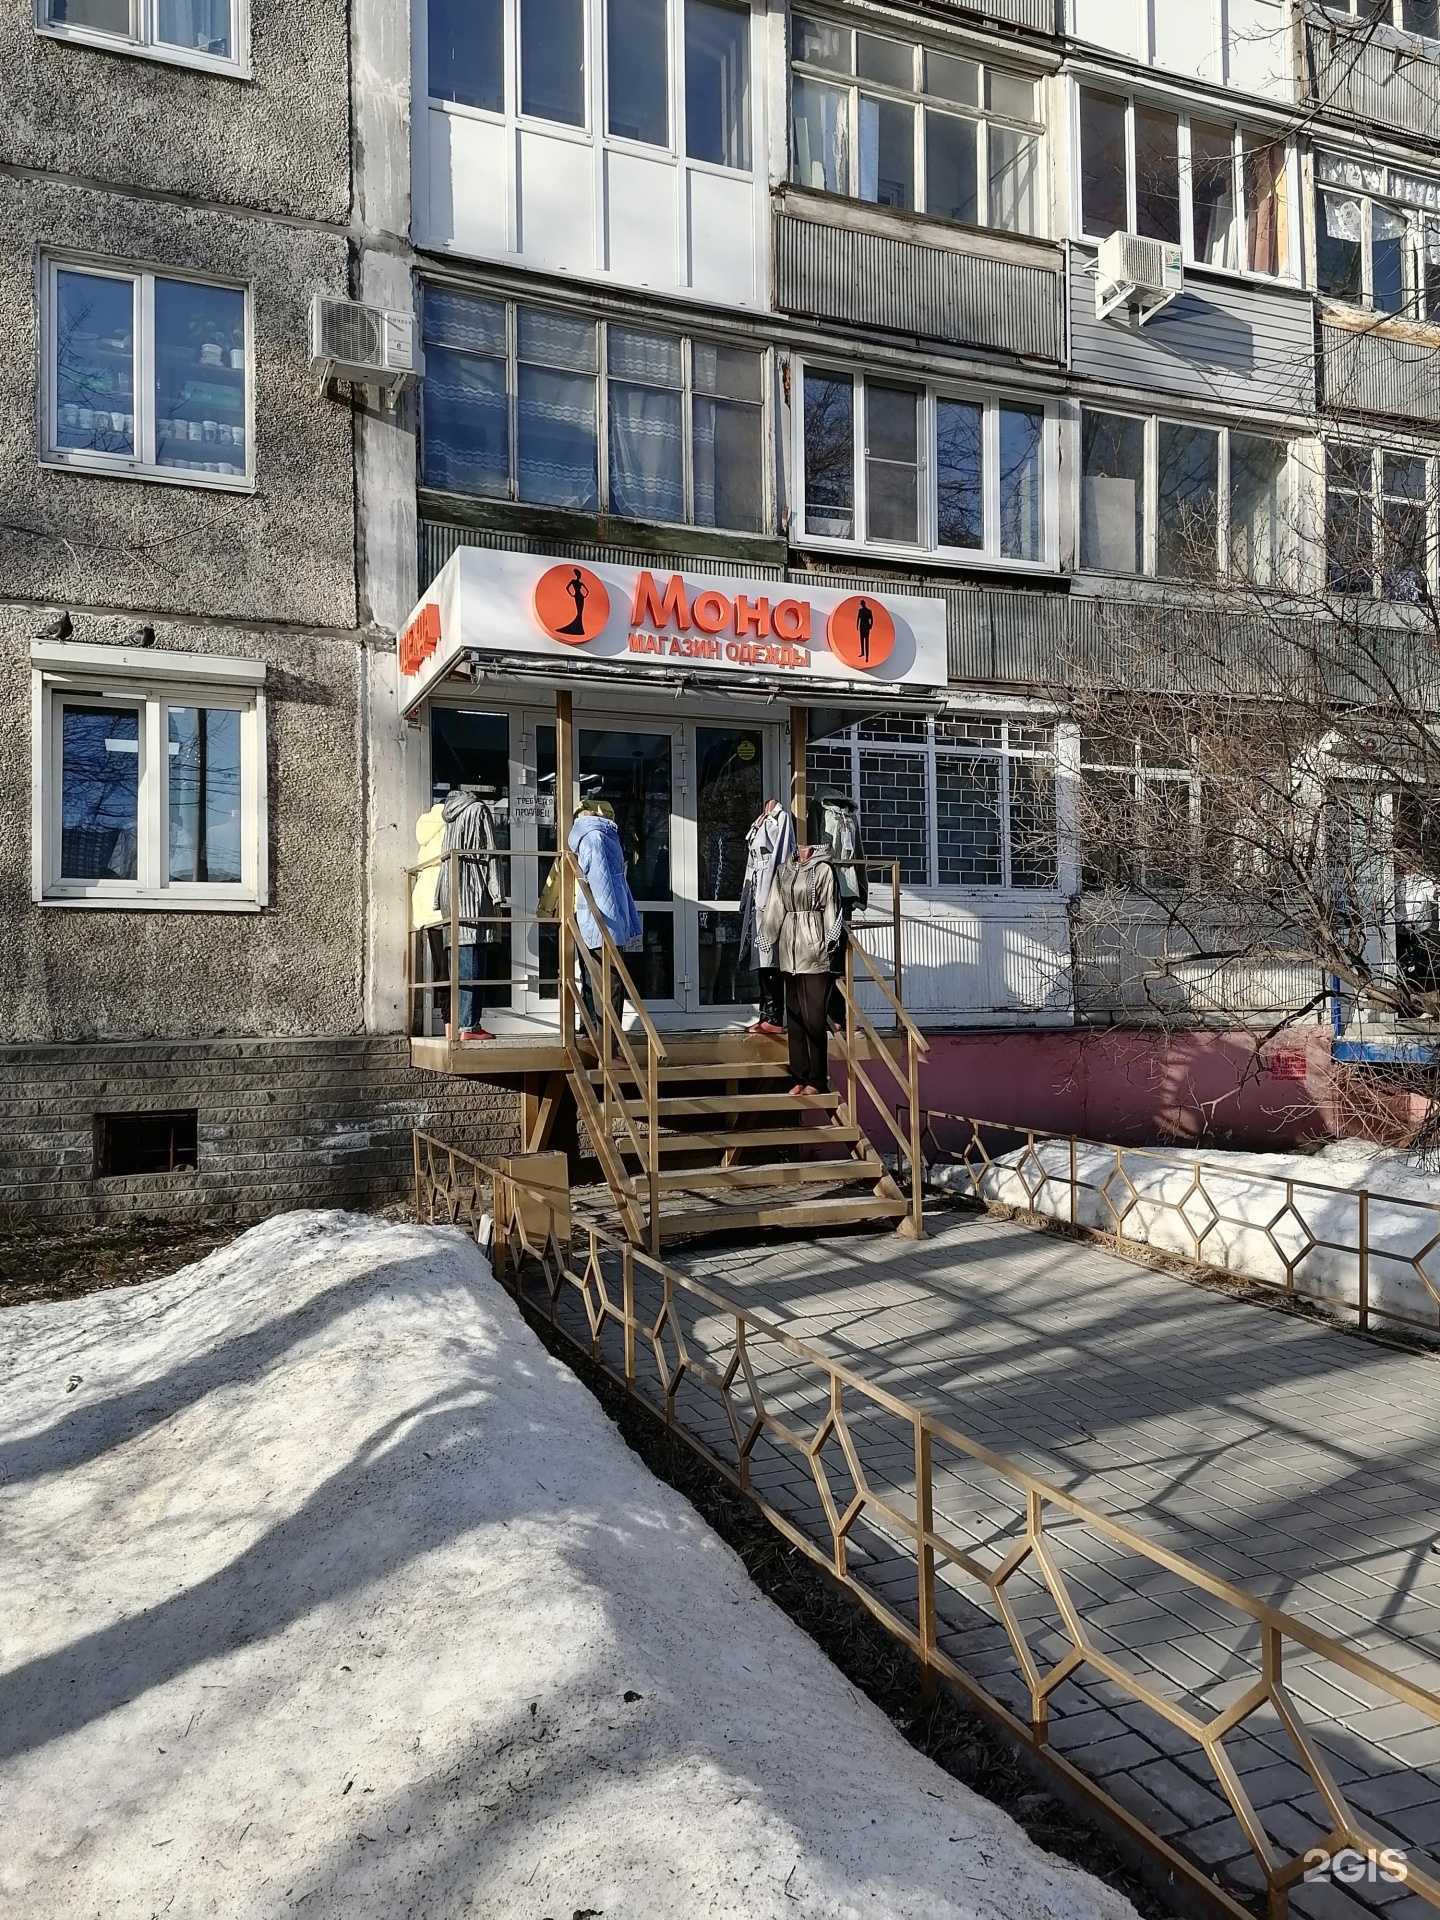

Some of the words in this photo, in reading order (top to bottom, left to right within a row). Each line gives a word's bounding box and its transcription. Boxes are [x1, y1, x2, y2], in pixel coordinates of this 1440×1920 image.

[631, 571, 811, 642] Мона
[628, 631, 722, 660] МАГАЗИН
[726, 641, 811, 669] ОДЕЖДЫ
